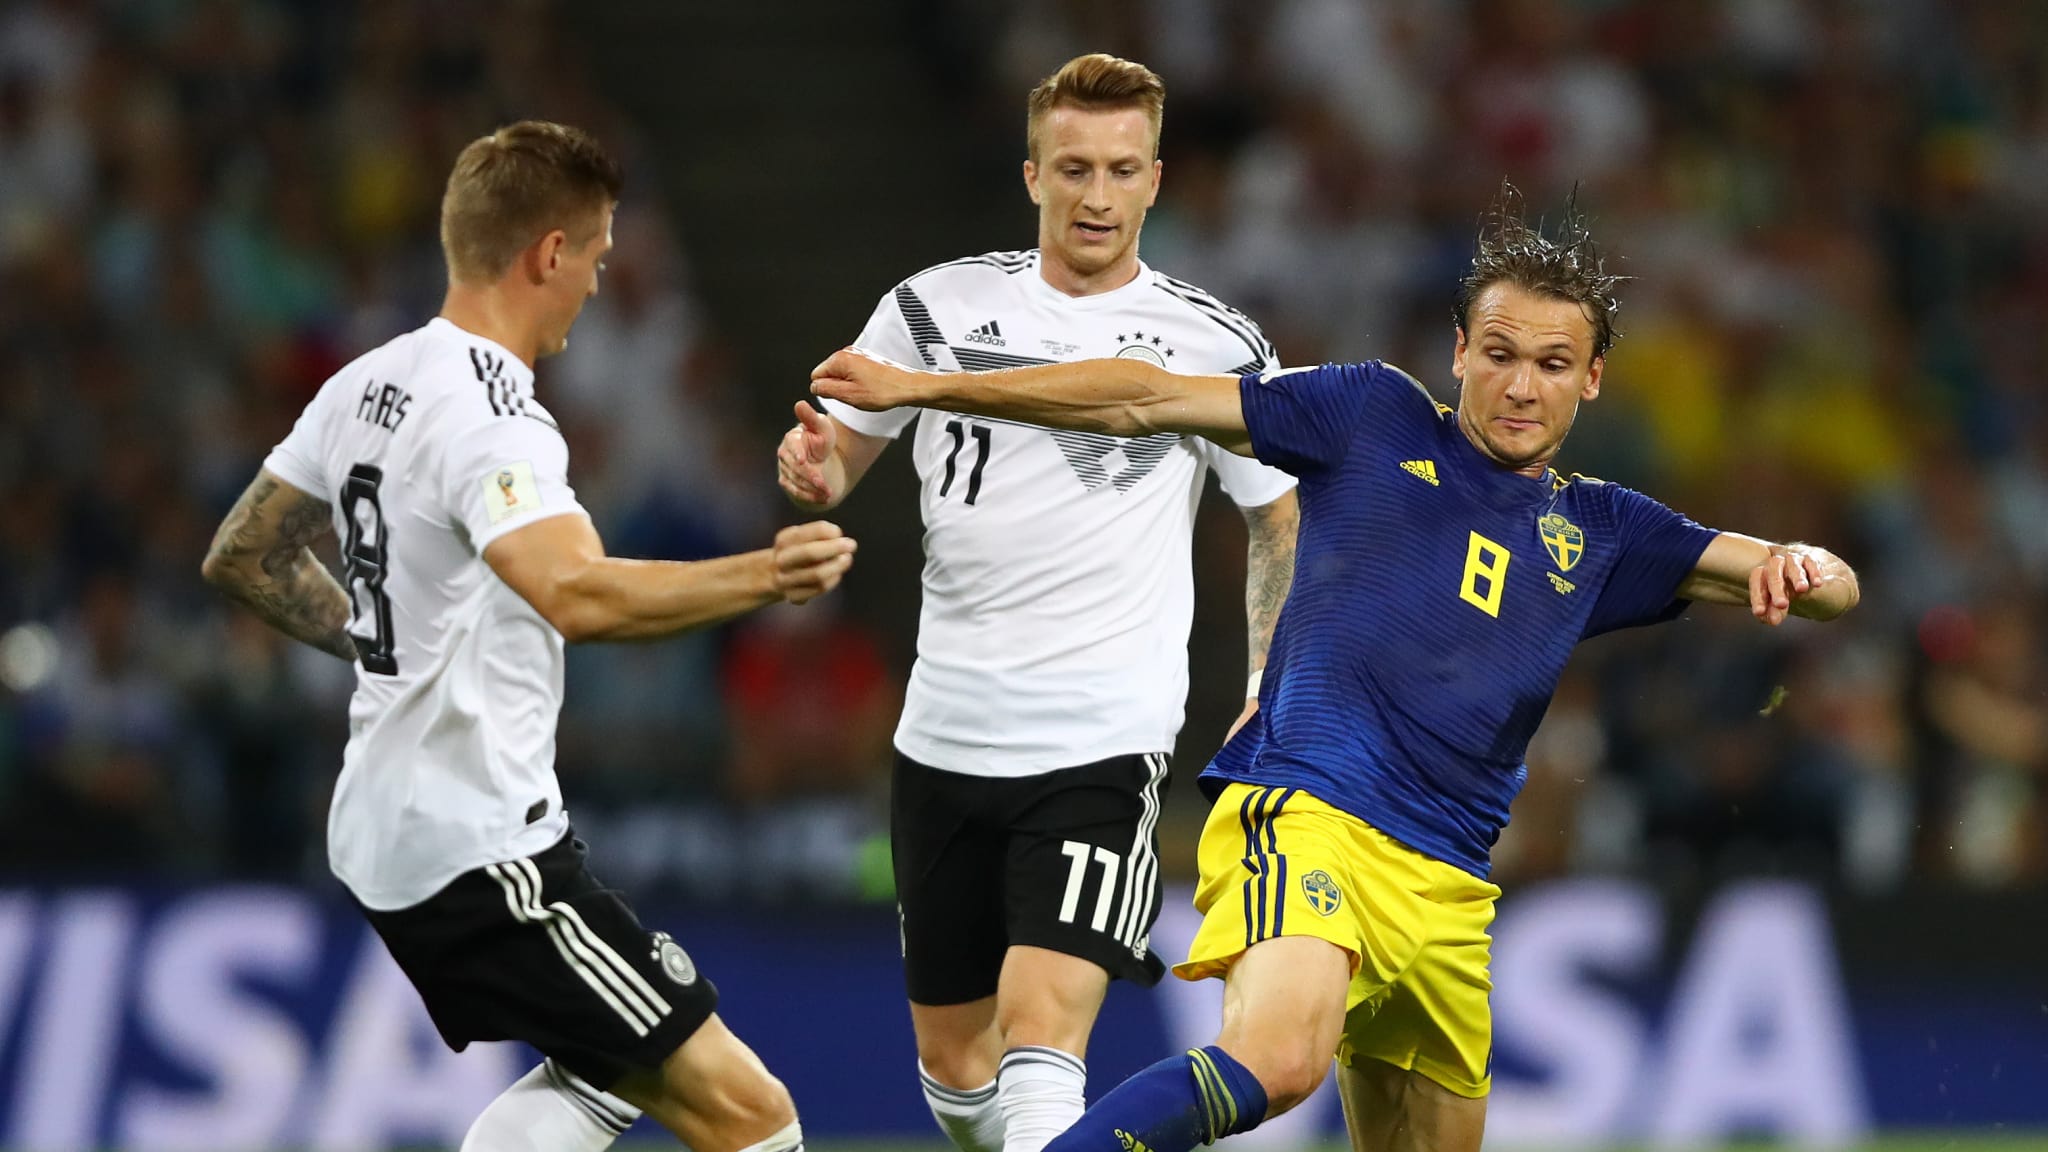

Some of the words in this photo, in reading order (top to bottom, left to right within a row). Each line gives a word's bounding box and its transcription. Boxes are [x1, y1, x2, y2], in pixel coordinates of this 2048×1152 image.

[965, 333, 1006, 347] adidas
[940, 420, 992, 506] 11
[1399, 461, 1440, 487] adidas
[340, 463, 398, 676] 8
[1459, 530, 1511, 619] 8
[1059, 840, 1120, 933] 11
[0, 884, 520, 1152] ISA
